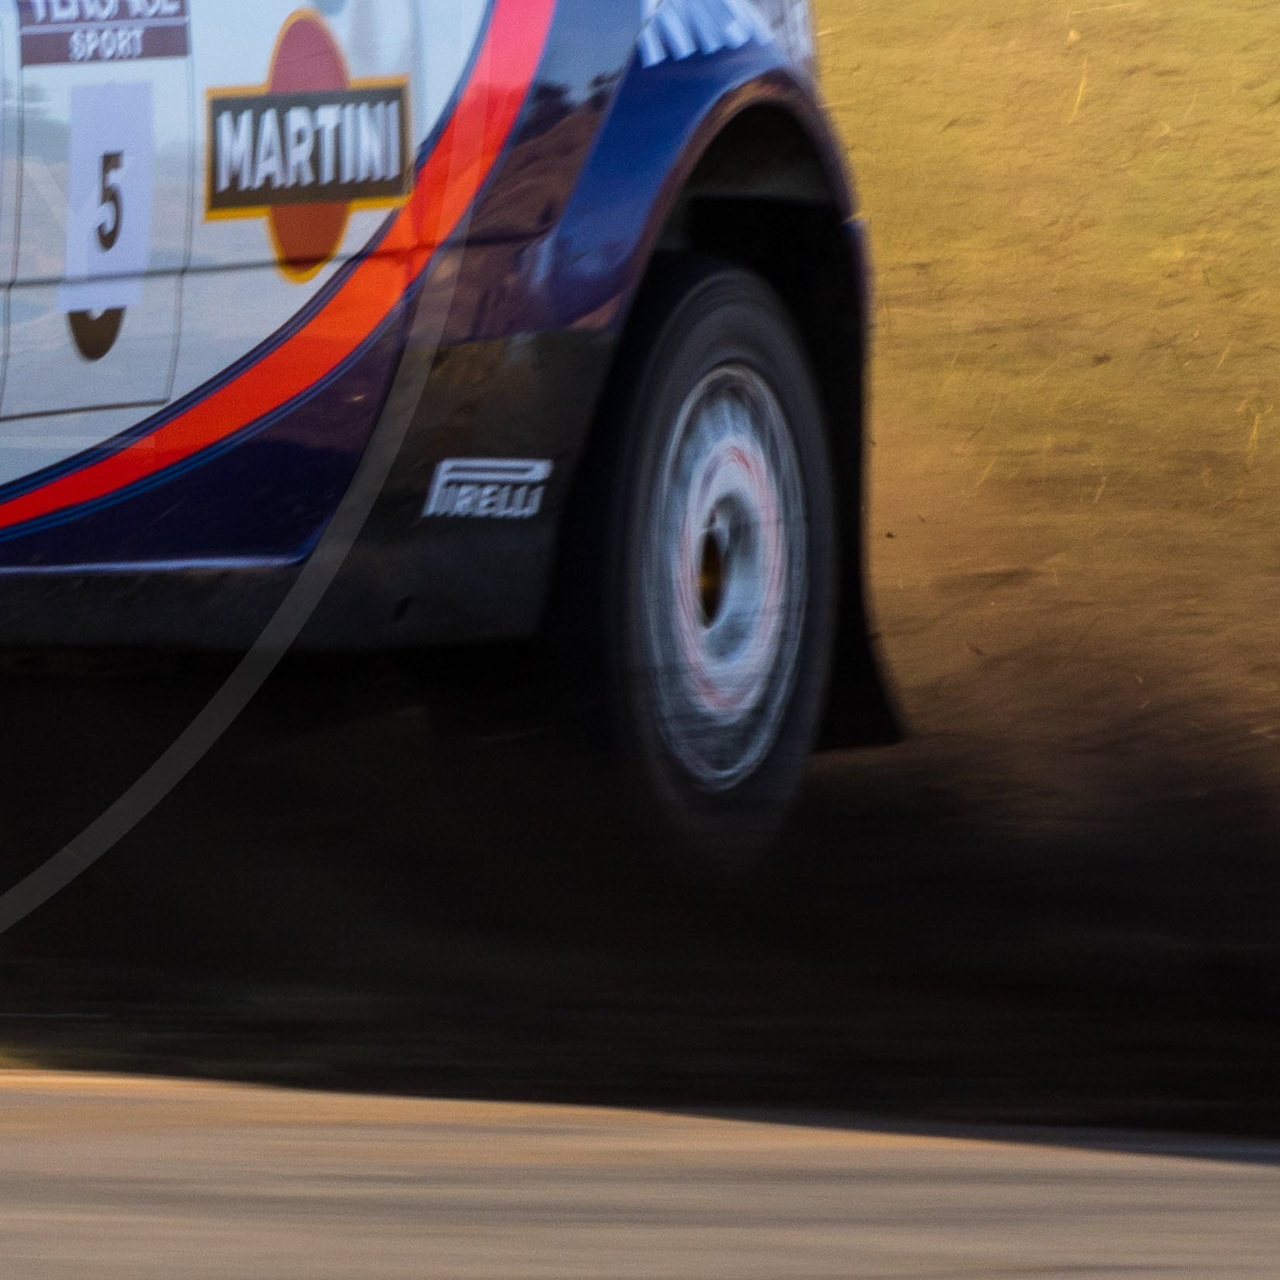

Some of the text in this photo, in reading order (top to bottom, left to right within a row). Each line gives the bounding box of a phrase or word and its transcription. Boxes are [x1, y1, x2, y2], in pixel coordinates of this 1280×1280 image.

[68, 28, 145, 62] SPORT
[213, 101, 400, 192] MARTINI
[94, 151, 125, 252] 5
[421, 458, 553, 520] PIRELLI
